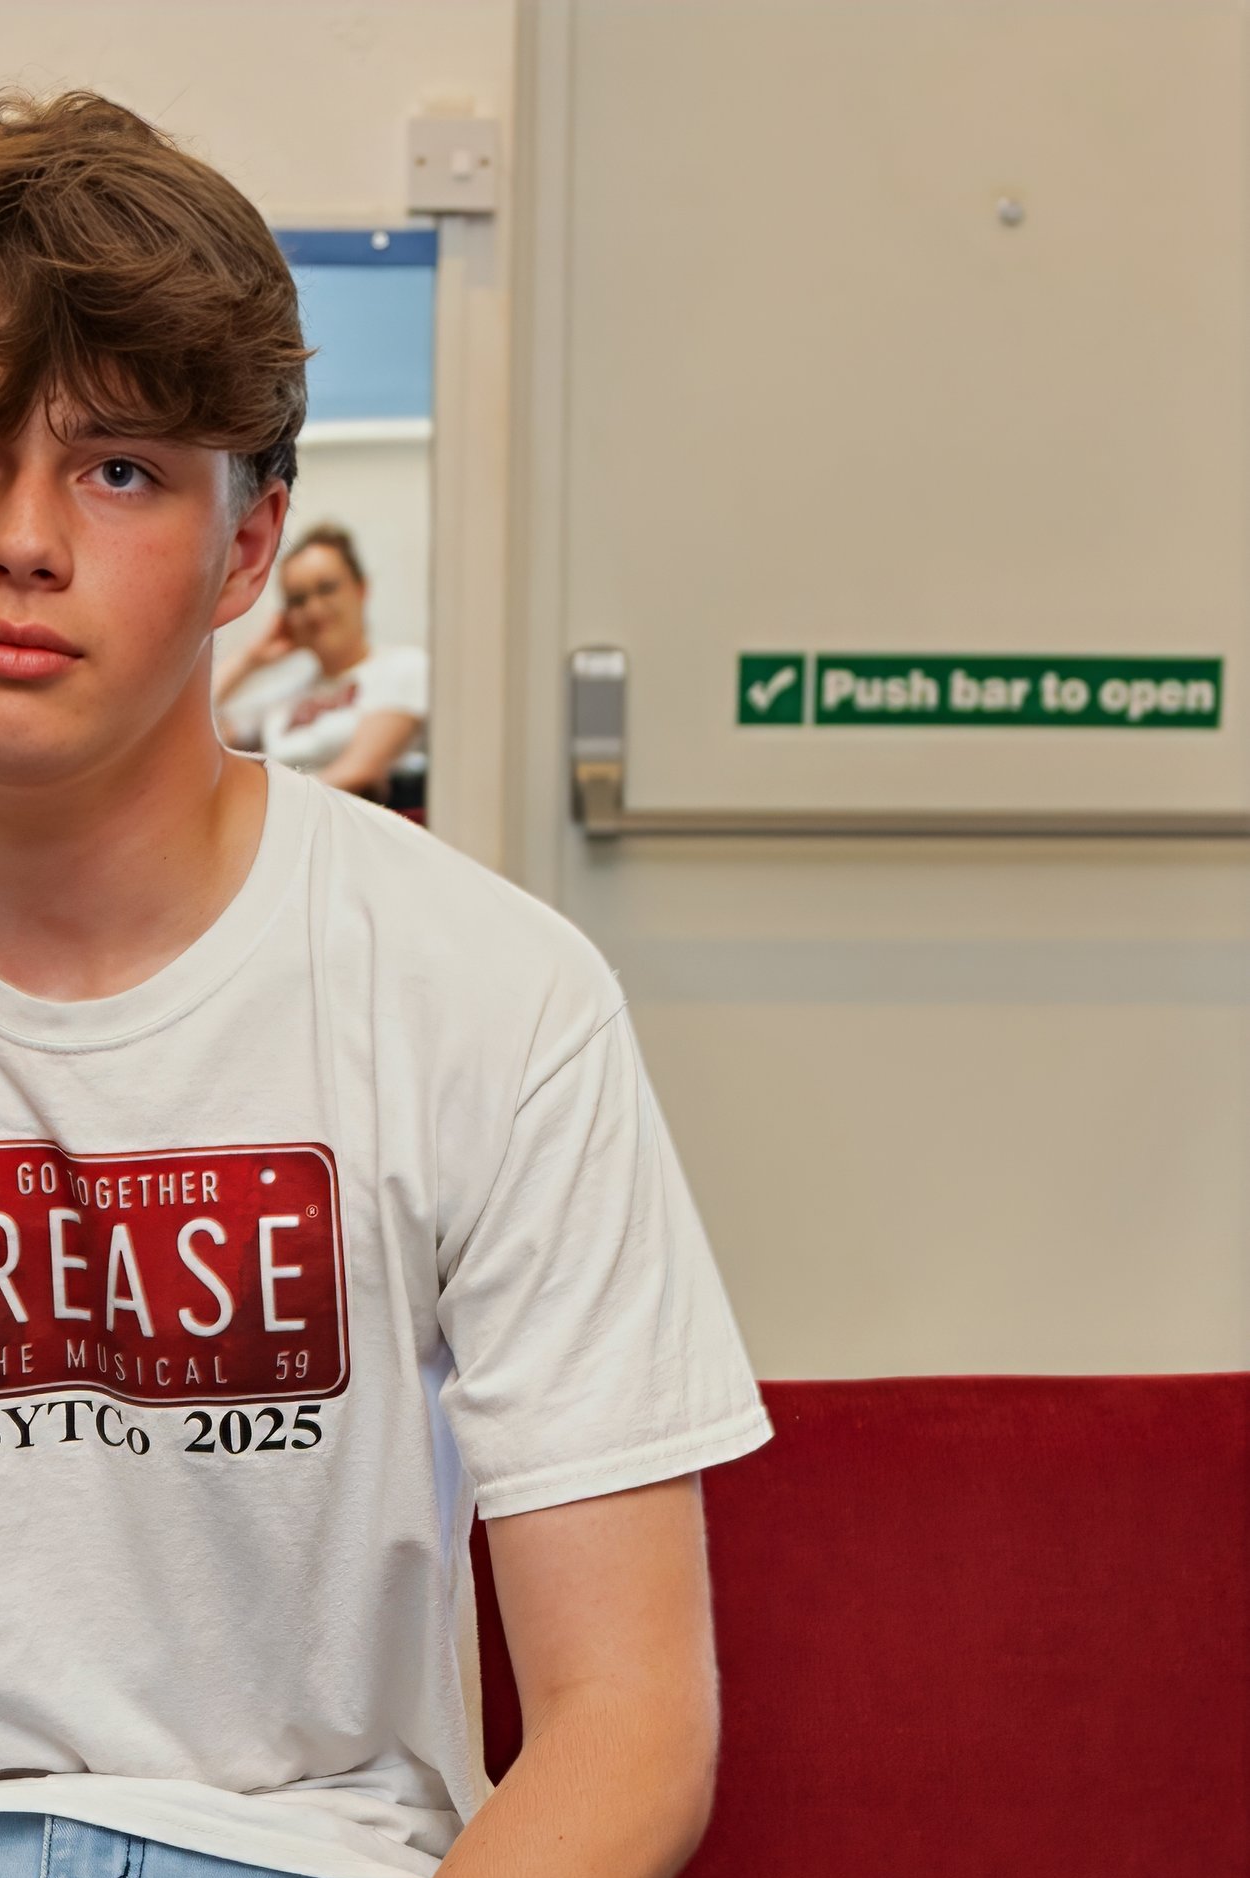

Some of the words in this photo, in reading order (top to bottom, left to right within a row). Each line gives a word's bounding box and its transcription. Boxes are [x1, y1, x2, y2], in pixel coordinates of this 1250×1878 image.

[821, 668, 940, 712] Push
[949, 668, 1031, 711] bar
[1039, 671, 1089, 711] to
[1098, 677, 1217, 721] open
[17, 1161, 58, 1195] GO
[66, 1169, 220, 1209] TOGETHER
[65, 1338, 229, 1387] MUSICAL
[275, 1349, 310, 1381] 59
[183, 1404, 324, 1455] 2025
